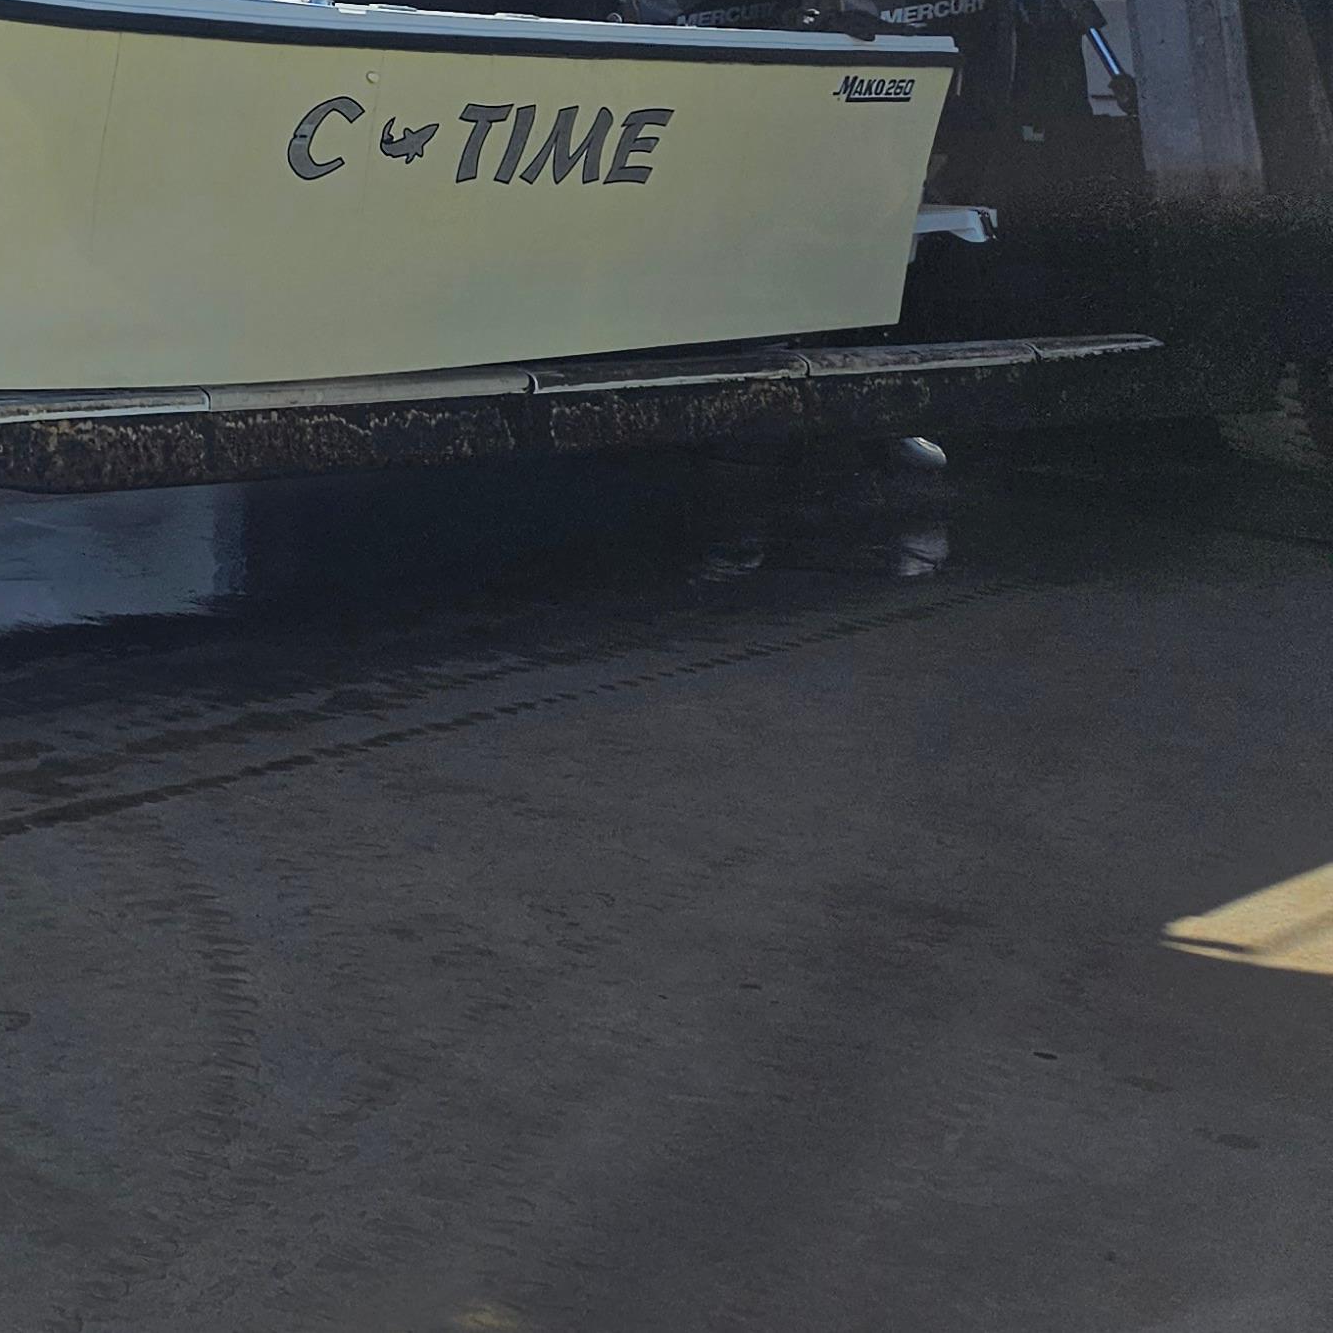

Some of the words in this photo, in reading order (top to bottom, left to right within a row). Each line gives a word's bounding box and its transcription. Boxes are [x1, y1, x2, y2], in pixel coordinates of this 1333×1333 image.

[884, 78, 915, 96] 260
[287, 96, 366, 181] C
[455, 102, 675, 185] TIME
